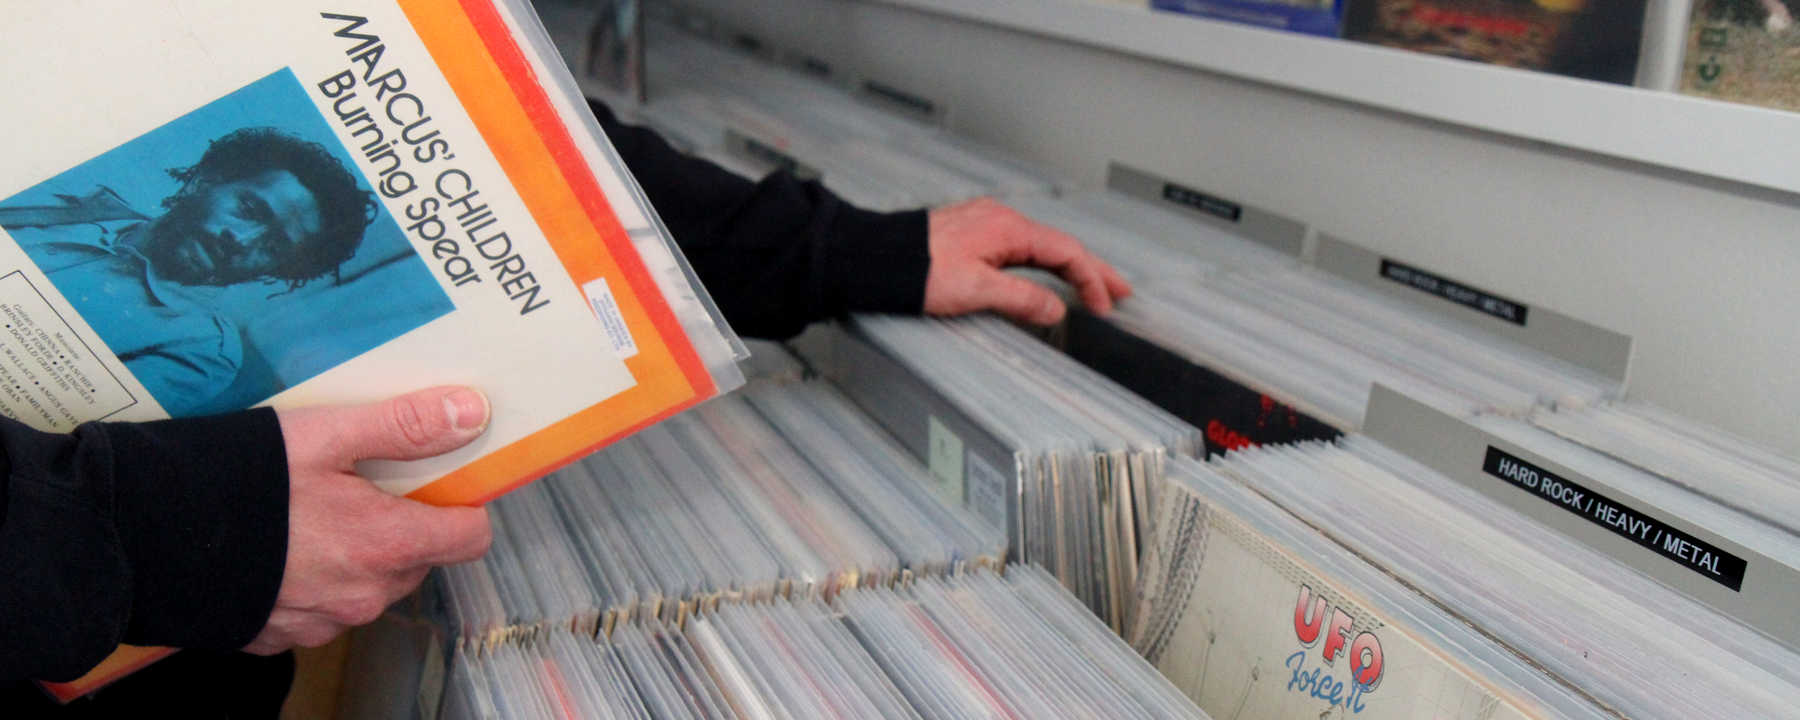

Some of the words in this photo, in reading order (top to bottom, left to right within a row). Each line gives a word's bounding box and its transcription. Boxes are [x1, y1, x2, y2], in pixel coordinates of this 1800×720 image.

[317, 68, 418, 199] Burning
[405, 197, 482, 287] Spear
[320, 12, 455, 163] MARCUS'
[435, 169, 551, 315] CHILDREN
[10, 328, 38, 357] DONALD
[1499, 457, 1539, 489] HARD
[1540, 478, 1584, 510] ROCK
[1585, 498, 1594, 513] /
[1595, 502, 1652, 541] HEAVY
[1653, 529, 1663, 545] /
[1664, 534, 1722, 576] METAL
[1285, 651, 1344, 705] Force
[1294, 583, 1384, 693] UFO
